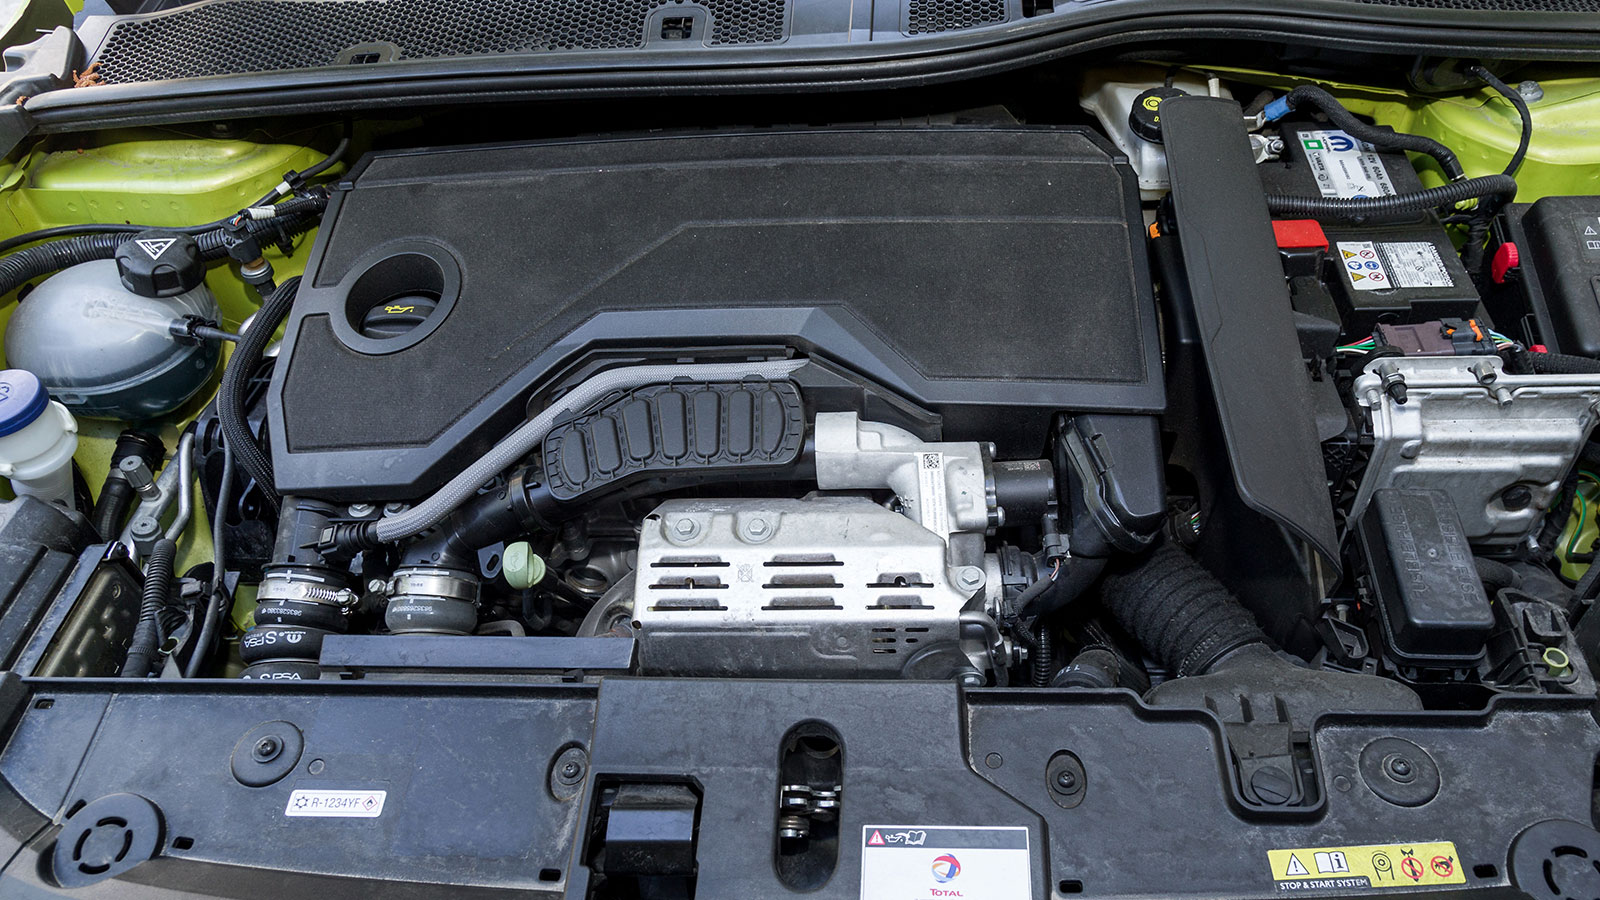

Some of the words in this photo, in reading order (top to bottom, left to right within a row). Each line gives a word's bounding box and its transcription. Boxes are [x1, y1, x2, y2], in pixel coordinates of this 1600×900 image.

[1454, 566, 1481, 603] FUSE
[311, 797, 361, 808] R-1234YF
[1280, 881, 1301, 890] STOP
[1303, 881, 1309, 889] &
[1310, 880, 1335, 888] START
[1336, 879, 1368, 887] SYSTEM
[929, 888, 964, 897] TOTAL
